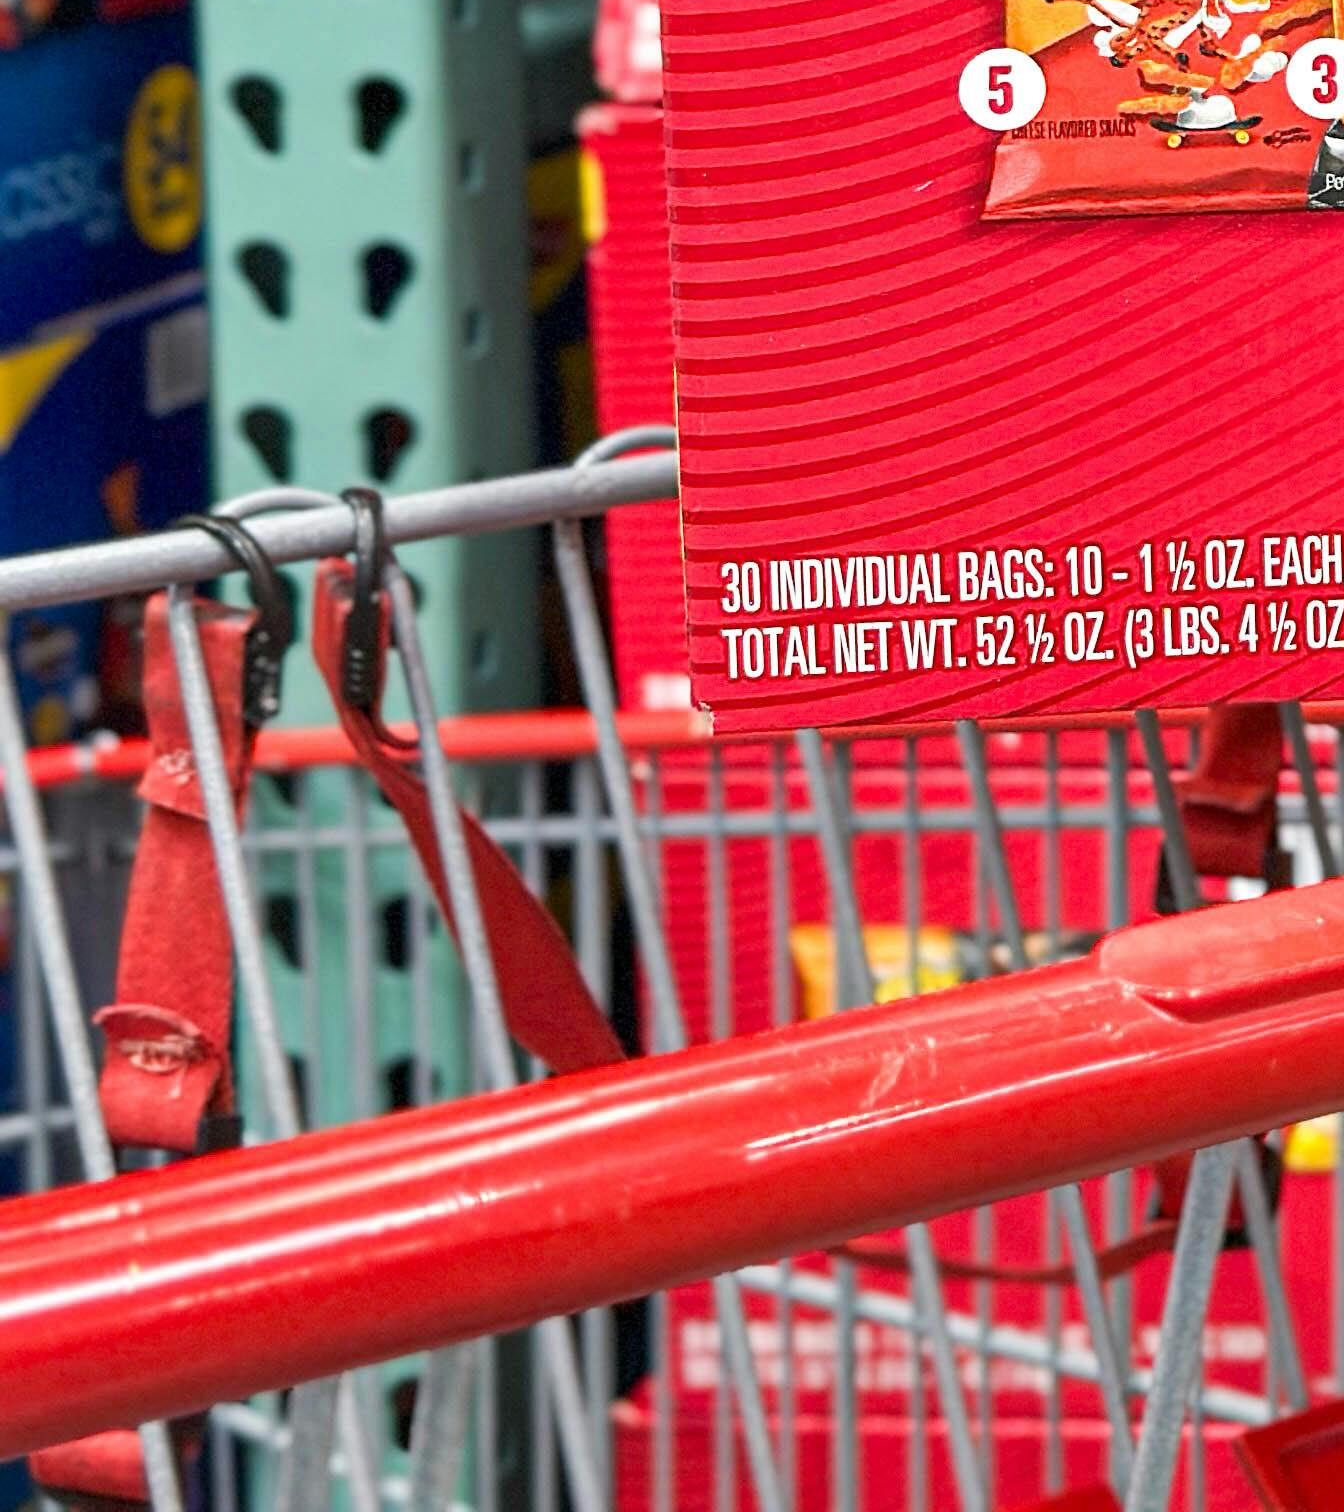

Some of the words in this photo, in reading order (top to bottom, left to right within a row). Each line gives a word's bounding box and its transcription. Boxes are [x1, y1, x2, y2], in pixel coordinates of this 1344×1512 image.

[988, 65, 1013, 113] 5
[1311, 54, 1338, 103] 3
[722, 562, 760, 612] 30
[770, 553, 949, 610] INDIVIDUAL
[958, 549, 1054, 601] BAGS:
[1066, 546, 1102, 596] 10
[1140, 544, 1152, 592] 1
[1205, 539, 1254, 589] OZ.
[721, 625, 826, 678] TOTAL
[834, 622, 893, 673] NET
[901, 619, 966, 669] WT.
[976, 616, 1015, 665] 52
[1065, 611, 1114, 661] OZ.
[1125, 609, 1153, 668] (3
[1164, 606, 1229, 656] LBS.
[1239, 604, 1258, 652] 4
